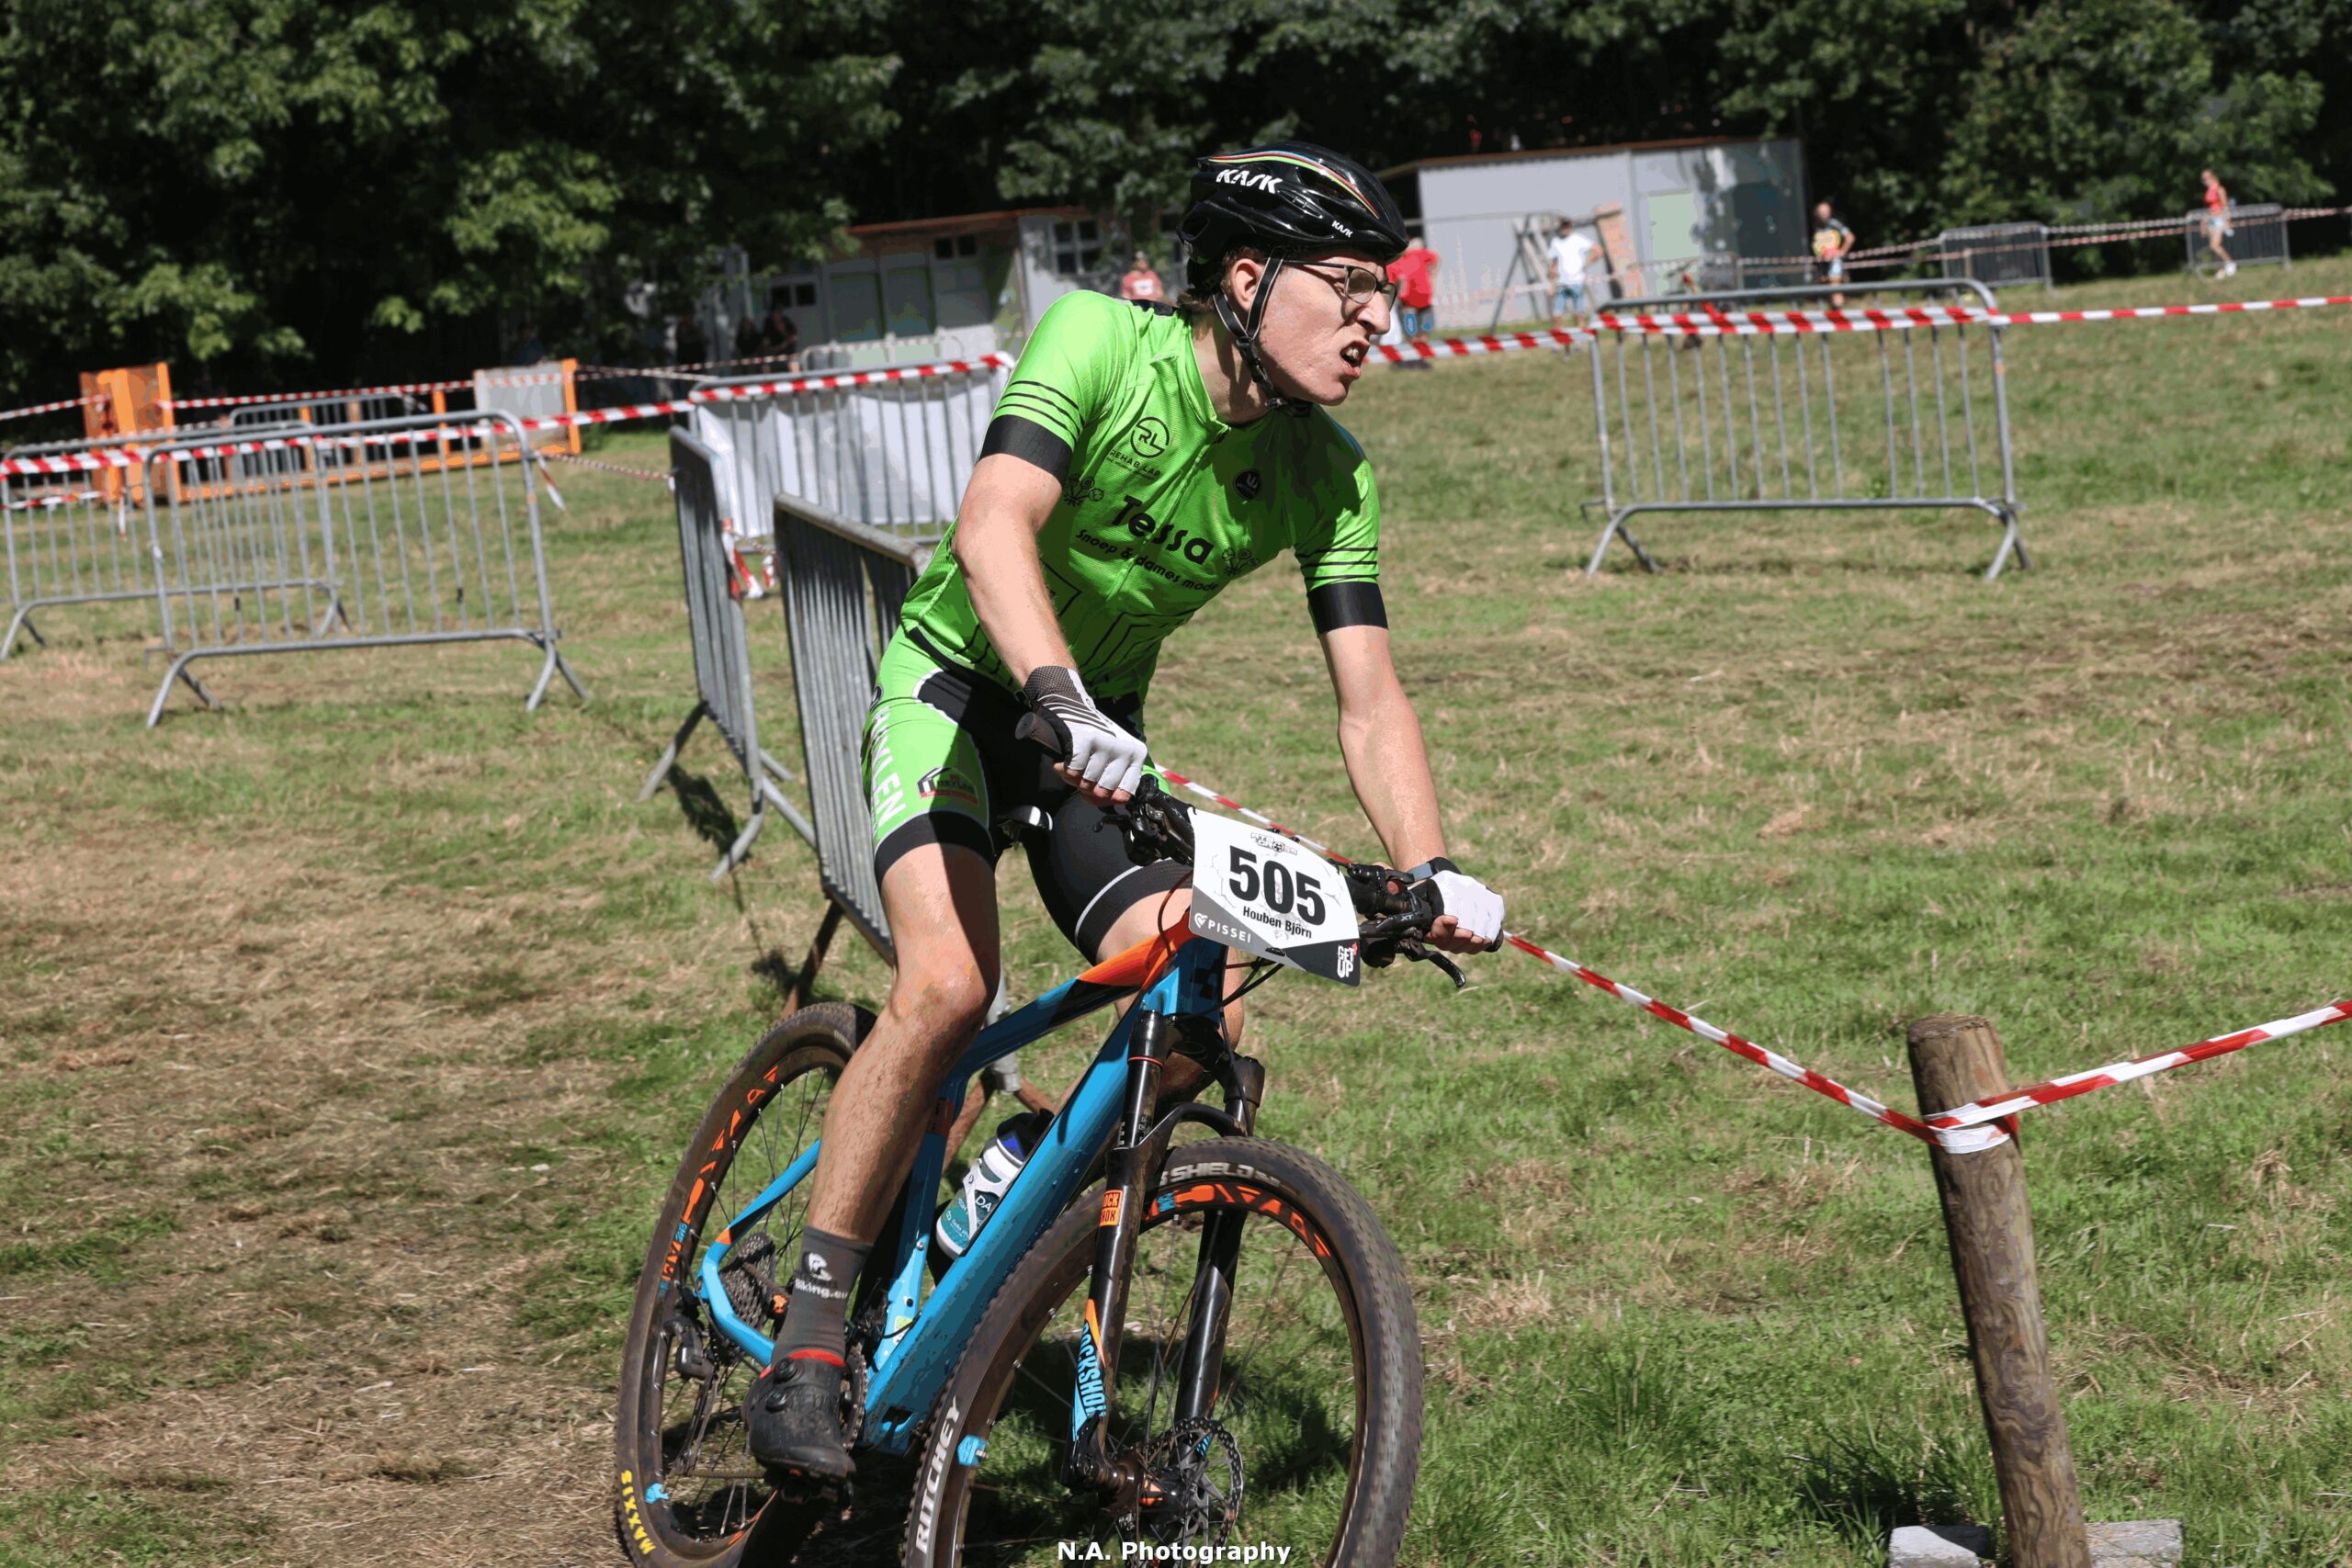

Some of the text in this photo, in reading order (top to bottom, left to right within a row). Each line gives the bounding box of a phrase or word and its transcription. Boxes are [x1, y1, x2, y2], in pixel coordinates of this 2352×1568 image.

[1216, 169, 1283, 194] KASK
[1331, 220, 1353, 238] KASK
[1109, 449, 1140, 468] REHAB
[1111, 495, 1215, 566] Tessa
[1075, 529, 1118, 554] Snoep
[1120, 547, 1136, 559] &
[1136, 556, 1180, 582] dames
[1228, 844, 1326, 927] 505
[1207, 921, 1251, 943] PISSEI
[1243, 906, 1312, 939] Houben Björn
[1337, 959, 1354, 978] UP
[1170, 1162, 1254, 1183] SHIELD
[1104, 1193, 1119, 1207] OCK
[915, 1395, 960, 1554] RITCHEY
[621, 1470, 657, 1555] MAXXIS
